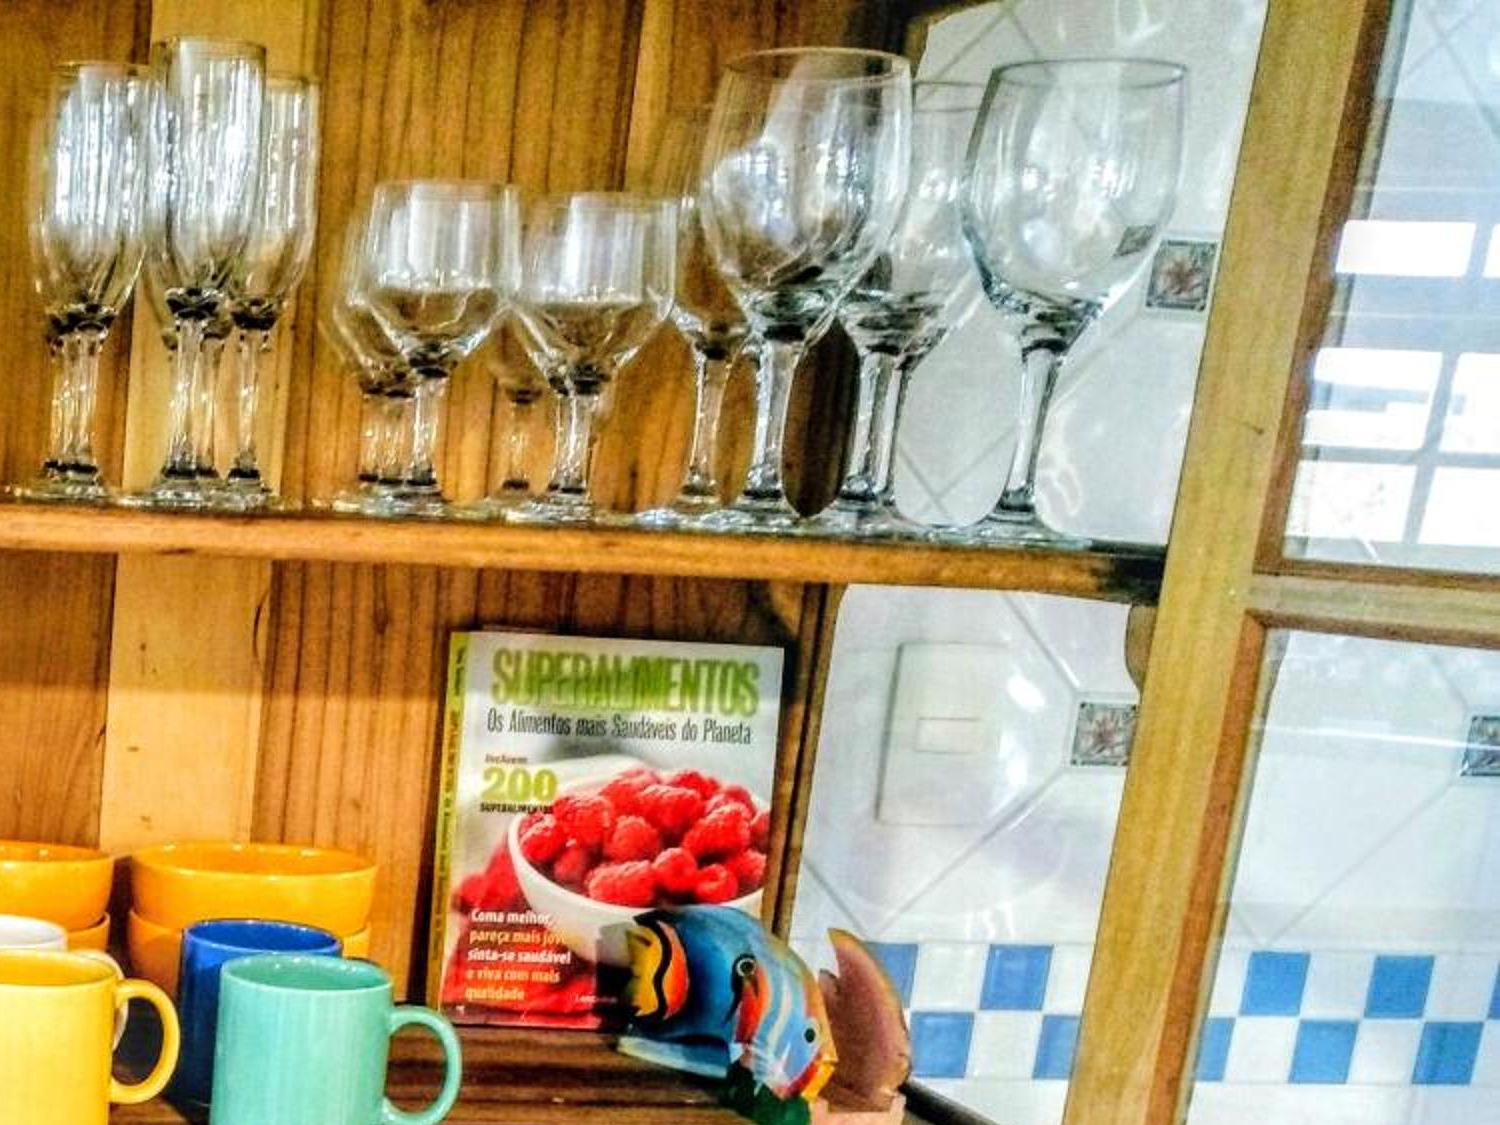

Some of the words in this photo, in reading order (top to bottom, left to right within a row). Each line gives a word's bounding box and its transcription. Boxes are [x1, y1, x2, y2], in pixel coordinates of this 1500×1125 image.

[492, 648, 761, 717] SUPERALIMENTOS
[487, 708, 504, 732] Os
[509, 709, 572, 735] Alimentos
[575, 712, 607, 737] mais
[611, 713, 677, 742] Saudáveis
[681, 718, 698, 741] do
[703, 719, 752, 745] Planeta
[482, 767, 558, 801] 200
[512, 929, 541, 944] mais
[532, 969, 560, 984] mais
